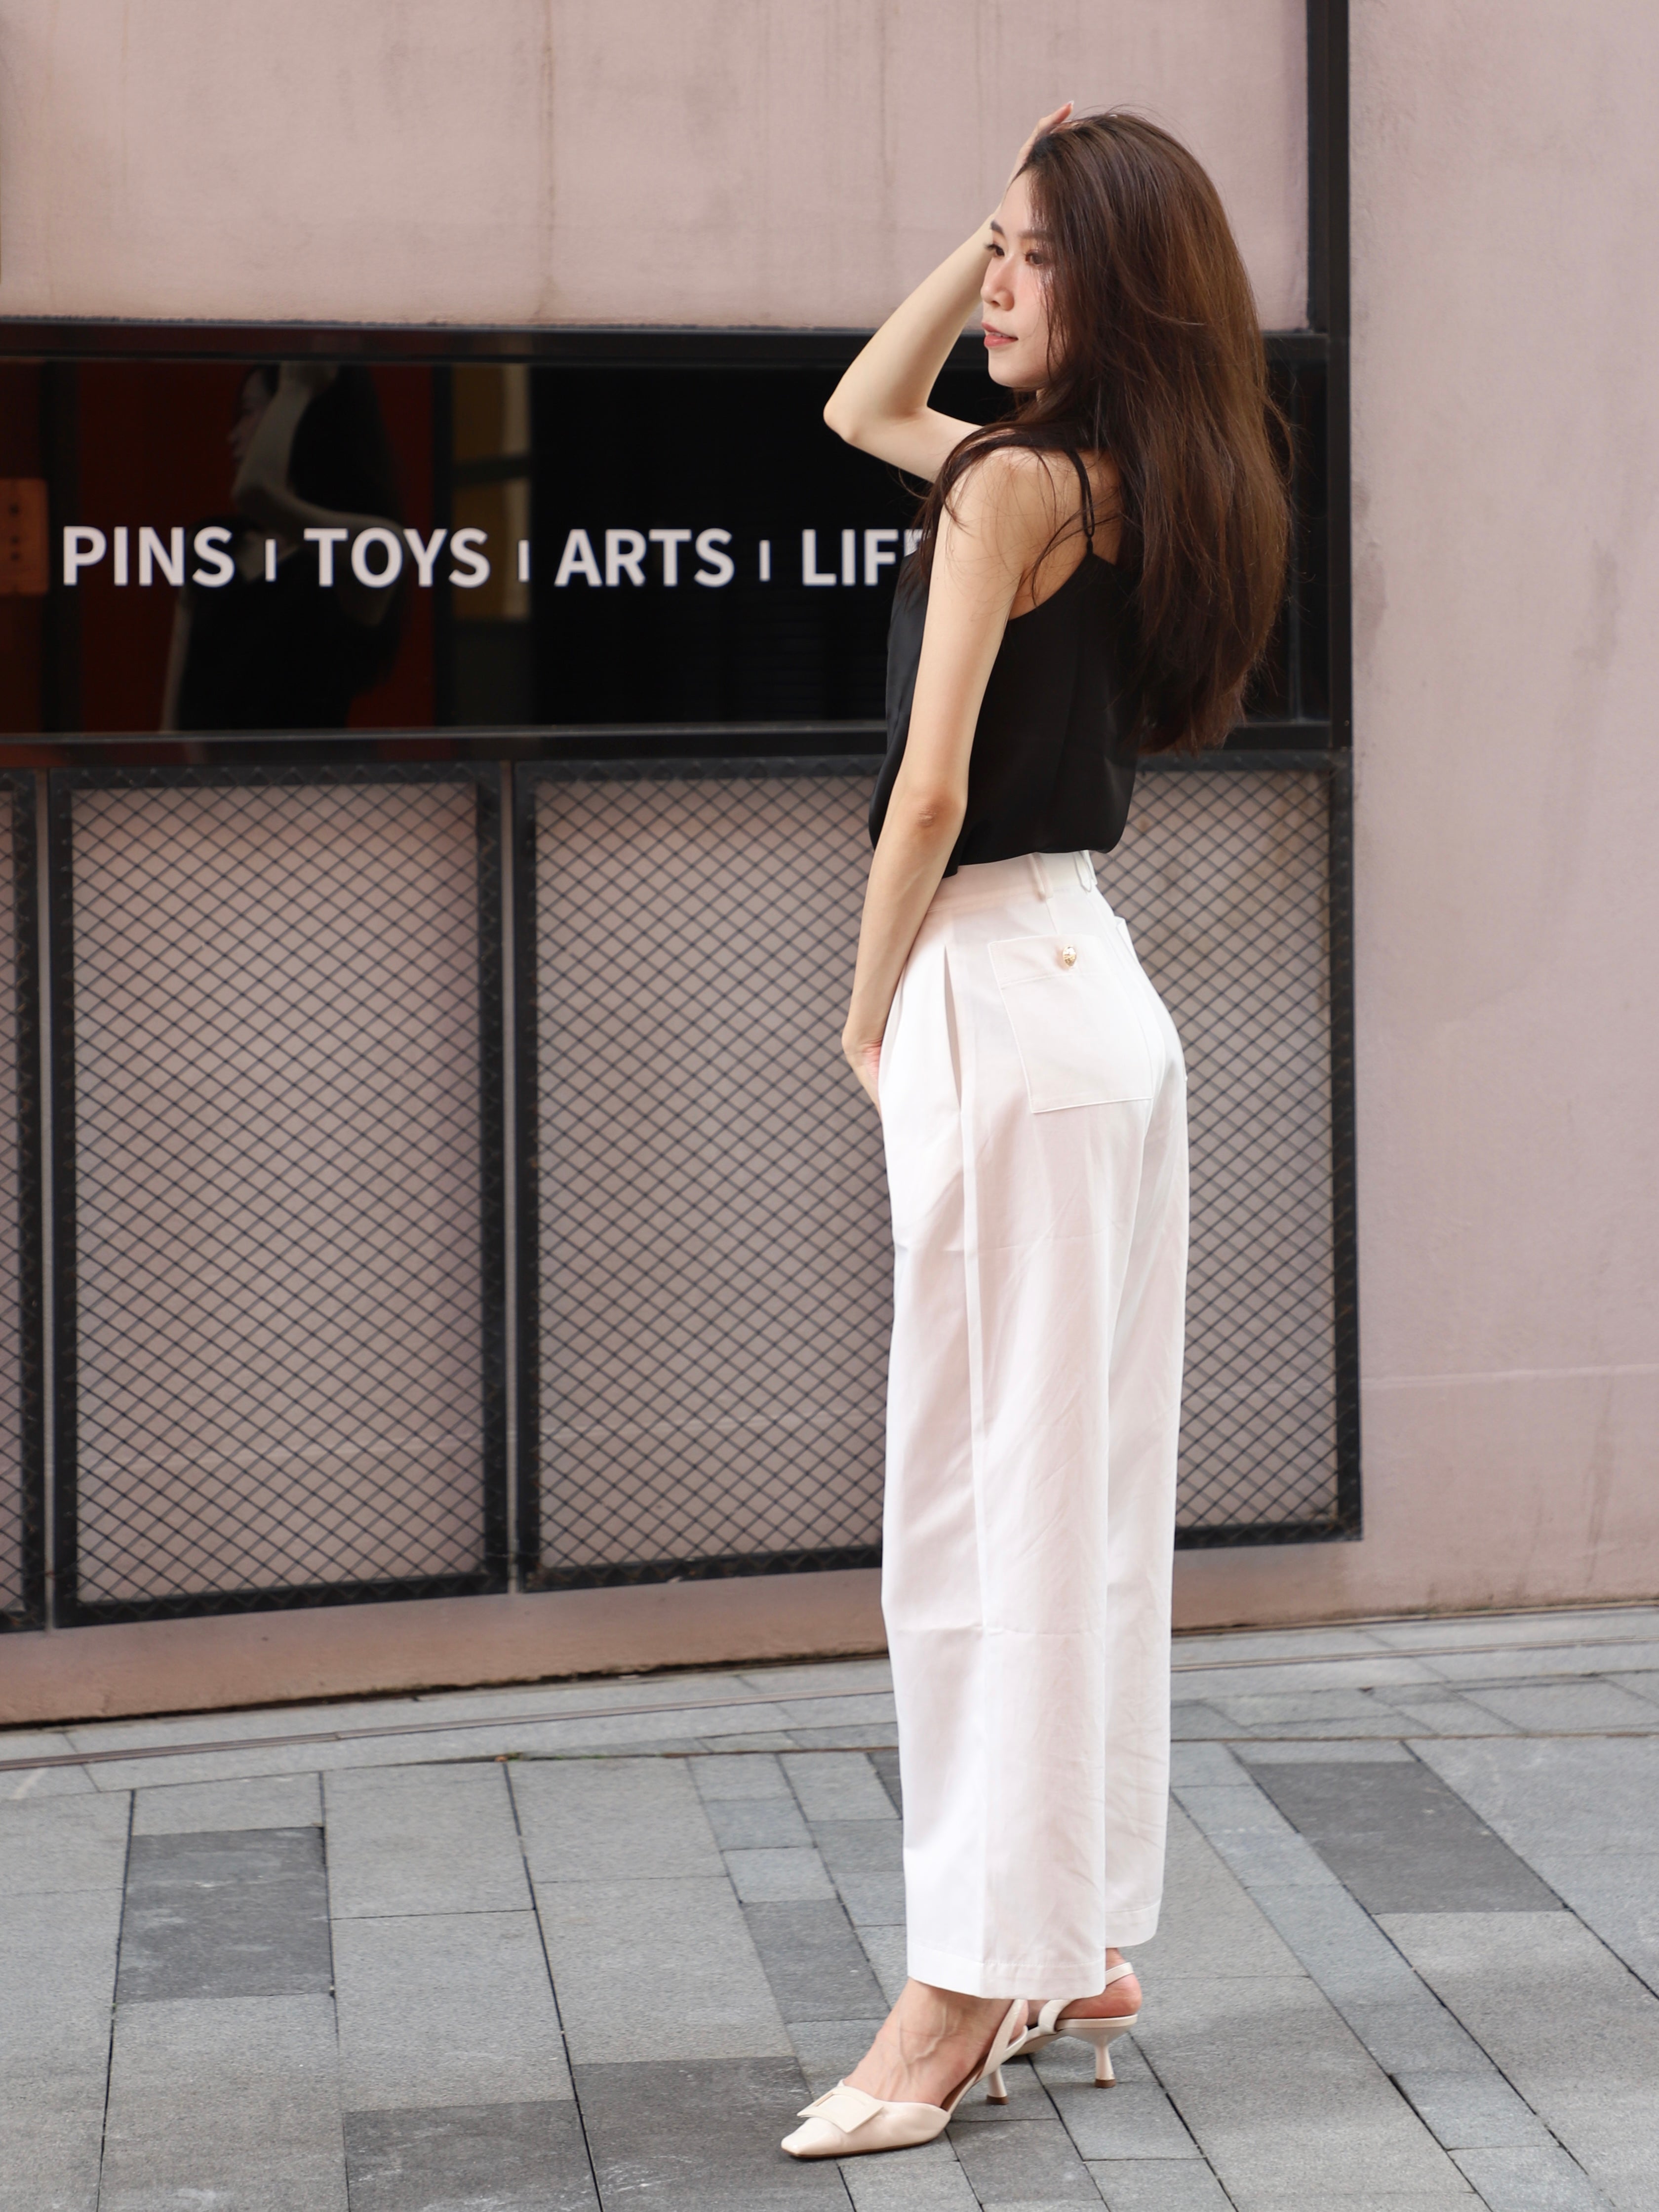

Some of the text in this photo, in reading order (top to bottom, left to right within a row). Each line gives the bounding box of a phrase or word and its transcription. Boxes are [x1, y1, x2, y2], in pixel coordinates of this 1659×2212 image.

[64, 527, 235, 587] PINS
[304, 528, 489, 587] TOYS
[555, 529, 734, 587] ARTS
